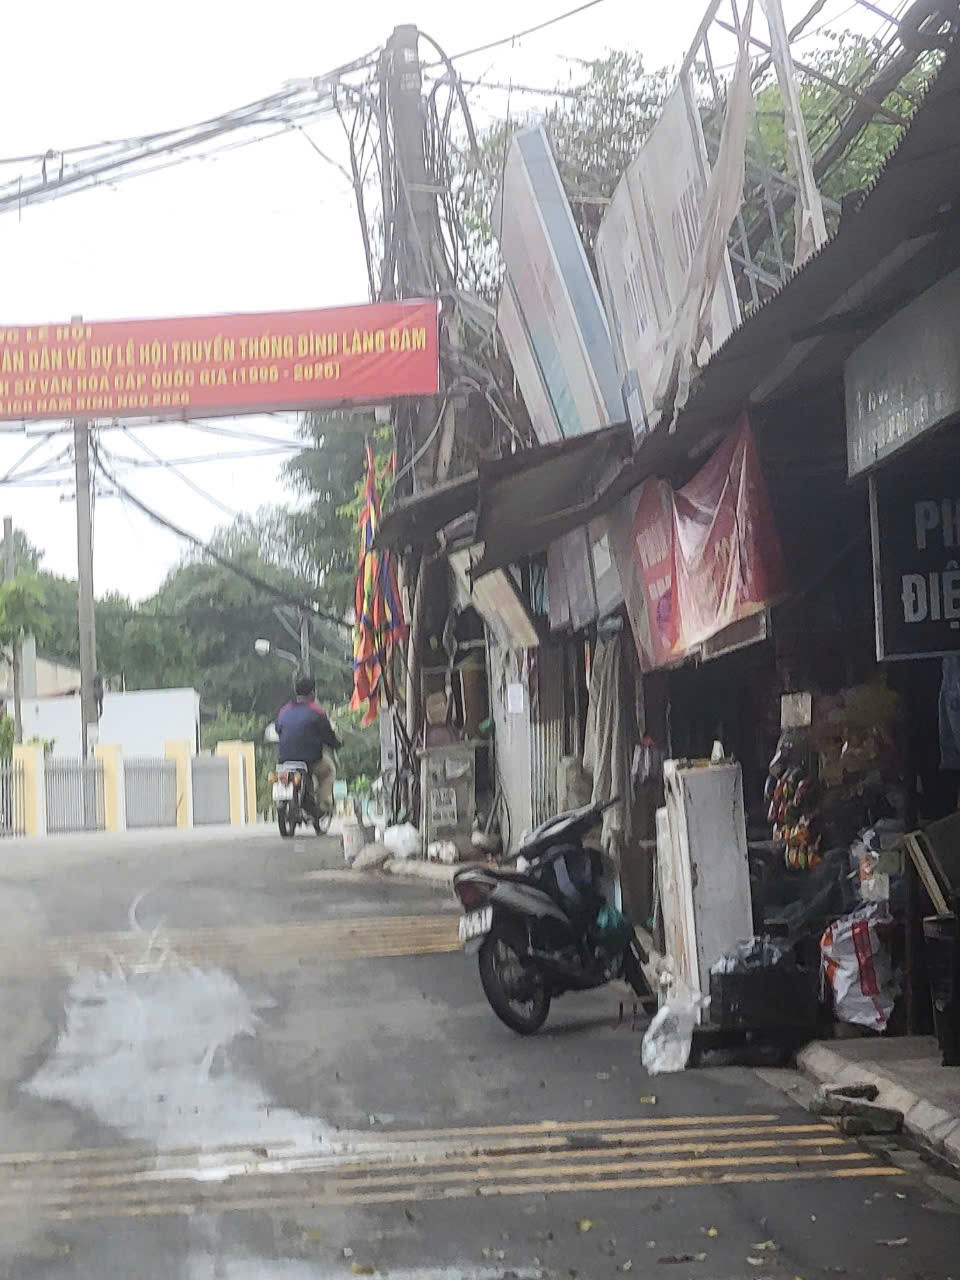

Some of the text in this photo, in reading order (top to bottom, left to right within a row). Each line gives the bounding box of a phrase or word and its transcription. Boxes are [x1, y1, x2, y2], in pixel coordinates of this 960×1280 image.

[28, 345, 62, 372] DÂN
[67, 340, 86, 370] VỀ
[91, 342, 114, 373] DỰ
[116, 337, 135, 368] LỄ
[139, 338, 167, 370] HỘI
[172, 332, 235, 364] TRUYỀN
[240, 328, 293, 361] THỐNG
[297, 329, 338, 358] ĐÌNH
[342, 328, 385, 355] LÀNG
[390, 327, 426, 352] CAM
[40, 374, 72, 394] VĂN
[114, 369, 146, 390] CẤP
[151, 368, 194, 389] QUỐC
[199, 367, 228, 386] GIA
